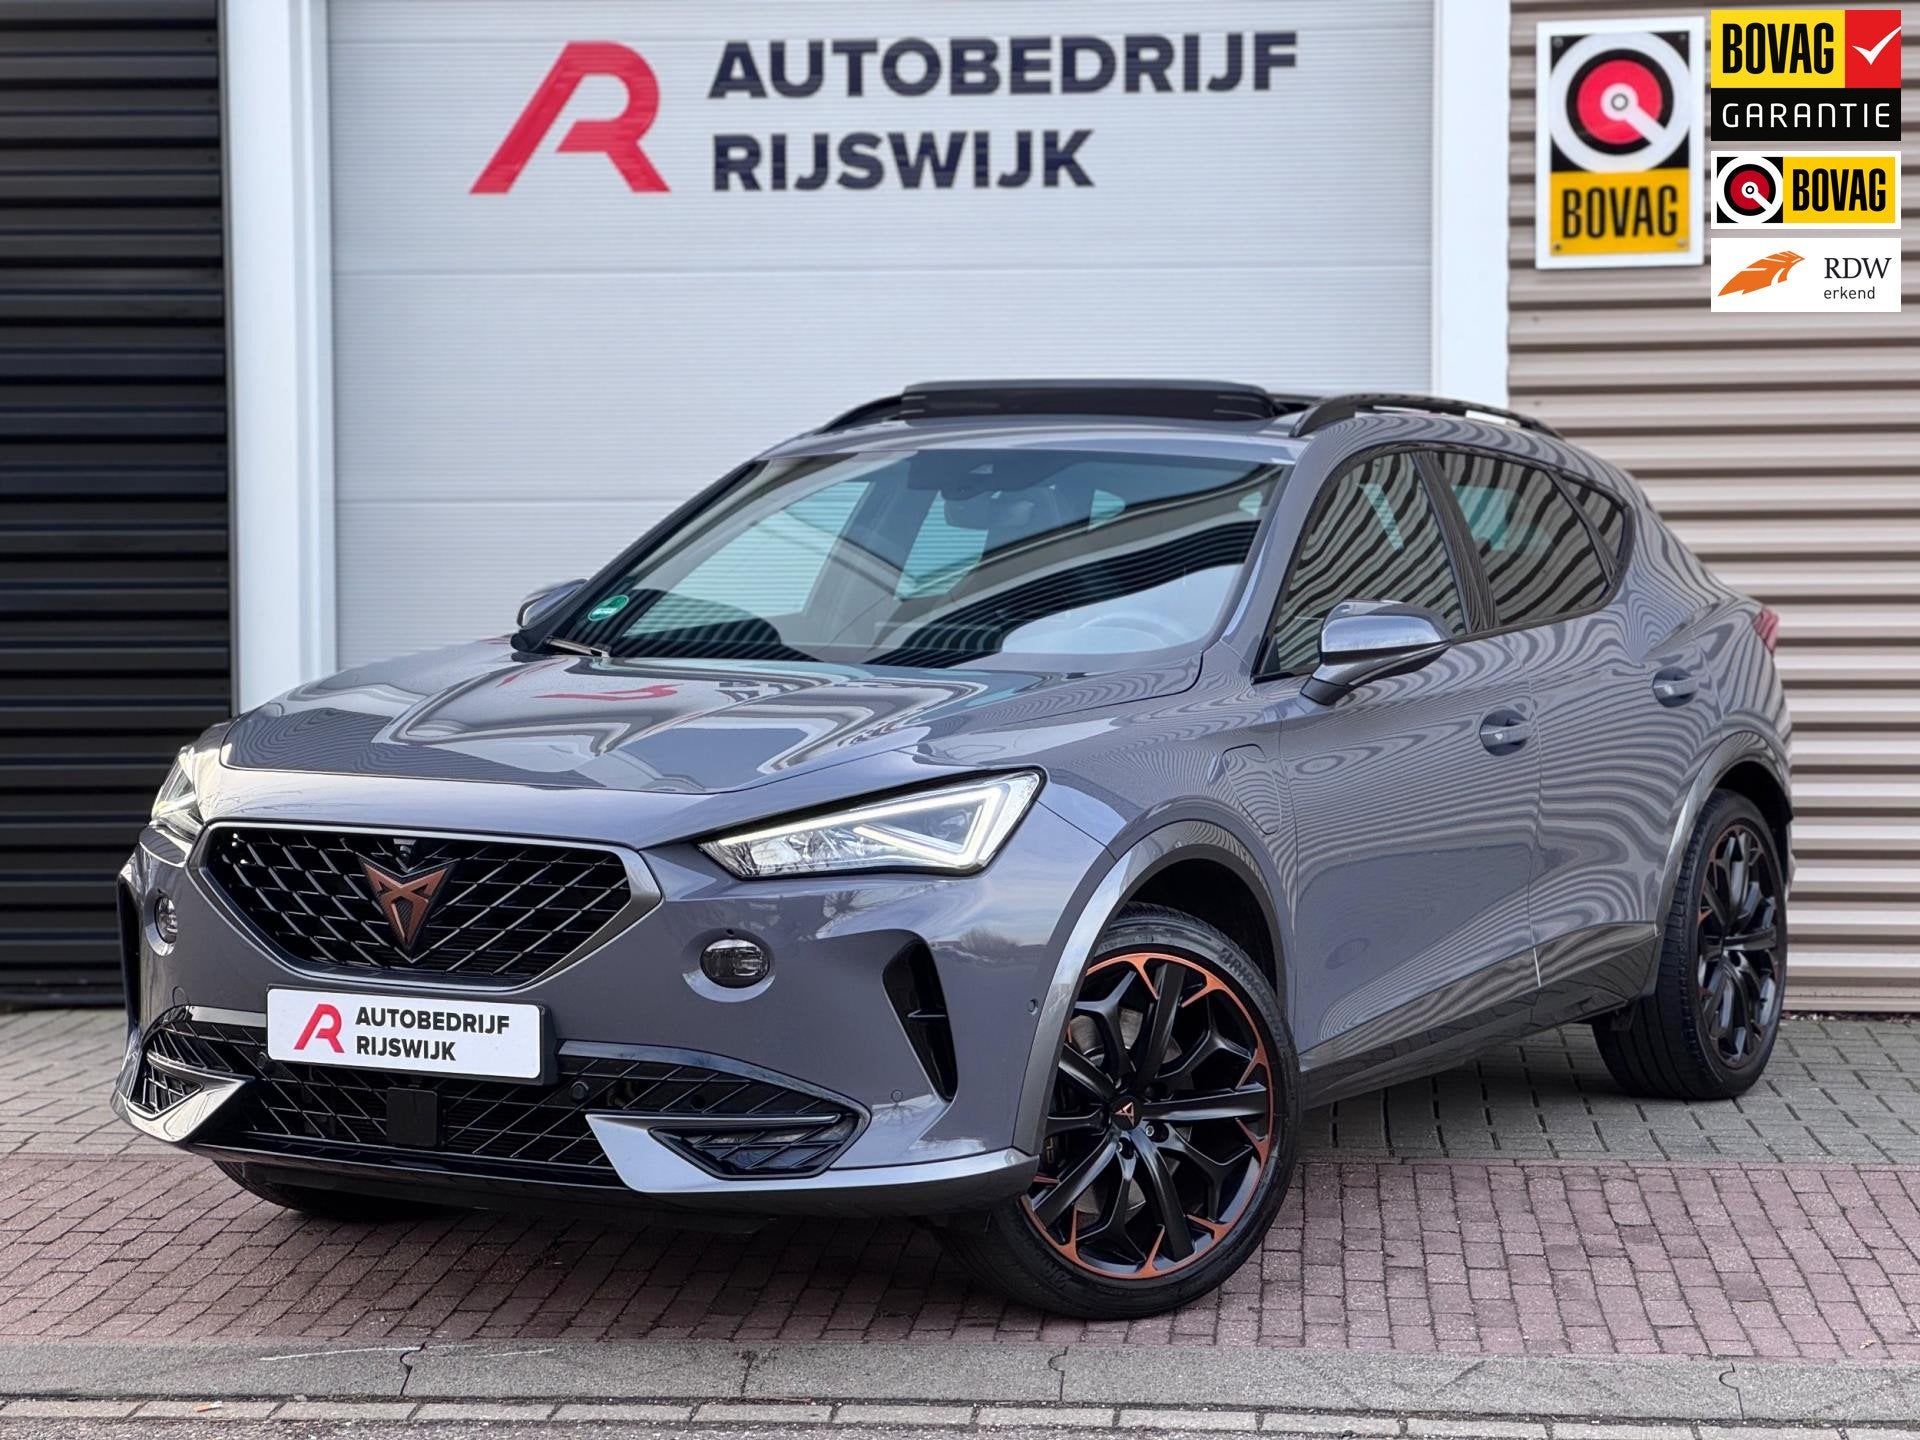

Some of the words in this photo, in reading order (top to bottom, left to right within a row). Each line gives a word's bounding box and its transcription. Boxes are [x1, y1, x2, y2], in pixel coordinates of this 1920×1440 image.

[708, 31, 1297, 99] AUTOBEDRIJF
[713, 129, 1094, 191] RIJSWIJK
[1562, 184, 1678, 239] BOVAG
[355, 1007, 509, 1034] AUTOBEDRIJF
[356, 1036, 456, 1061] RIJSWIJK
